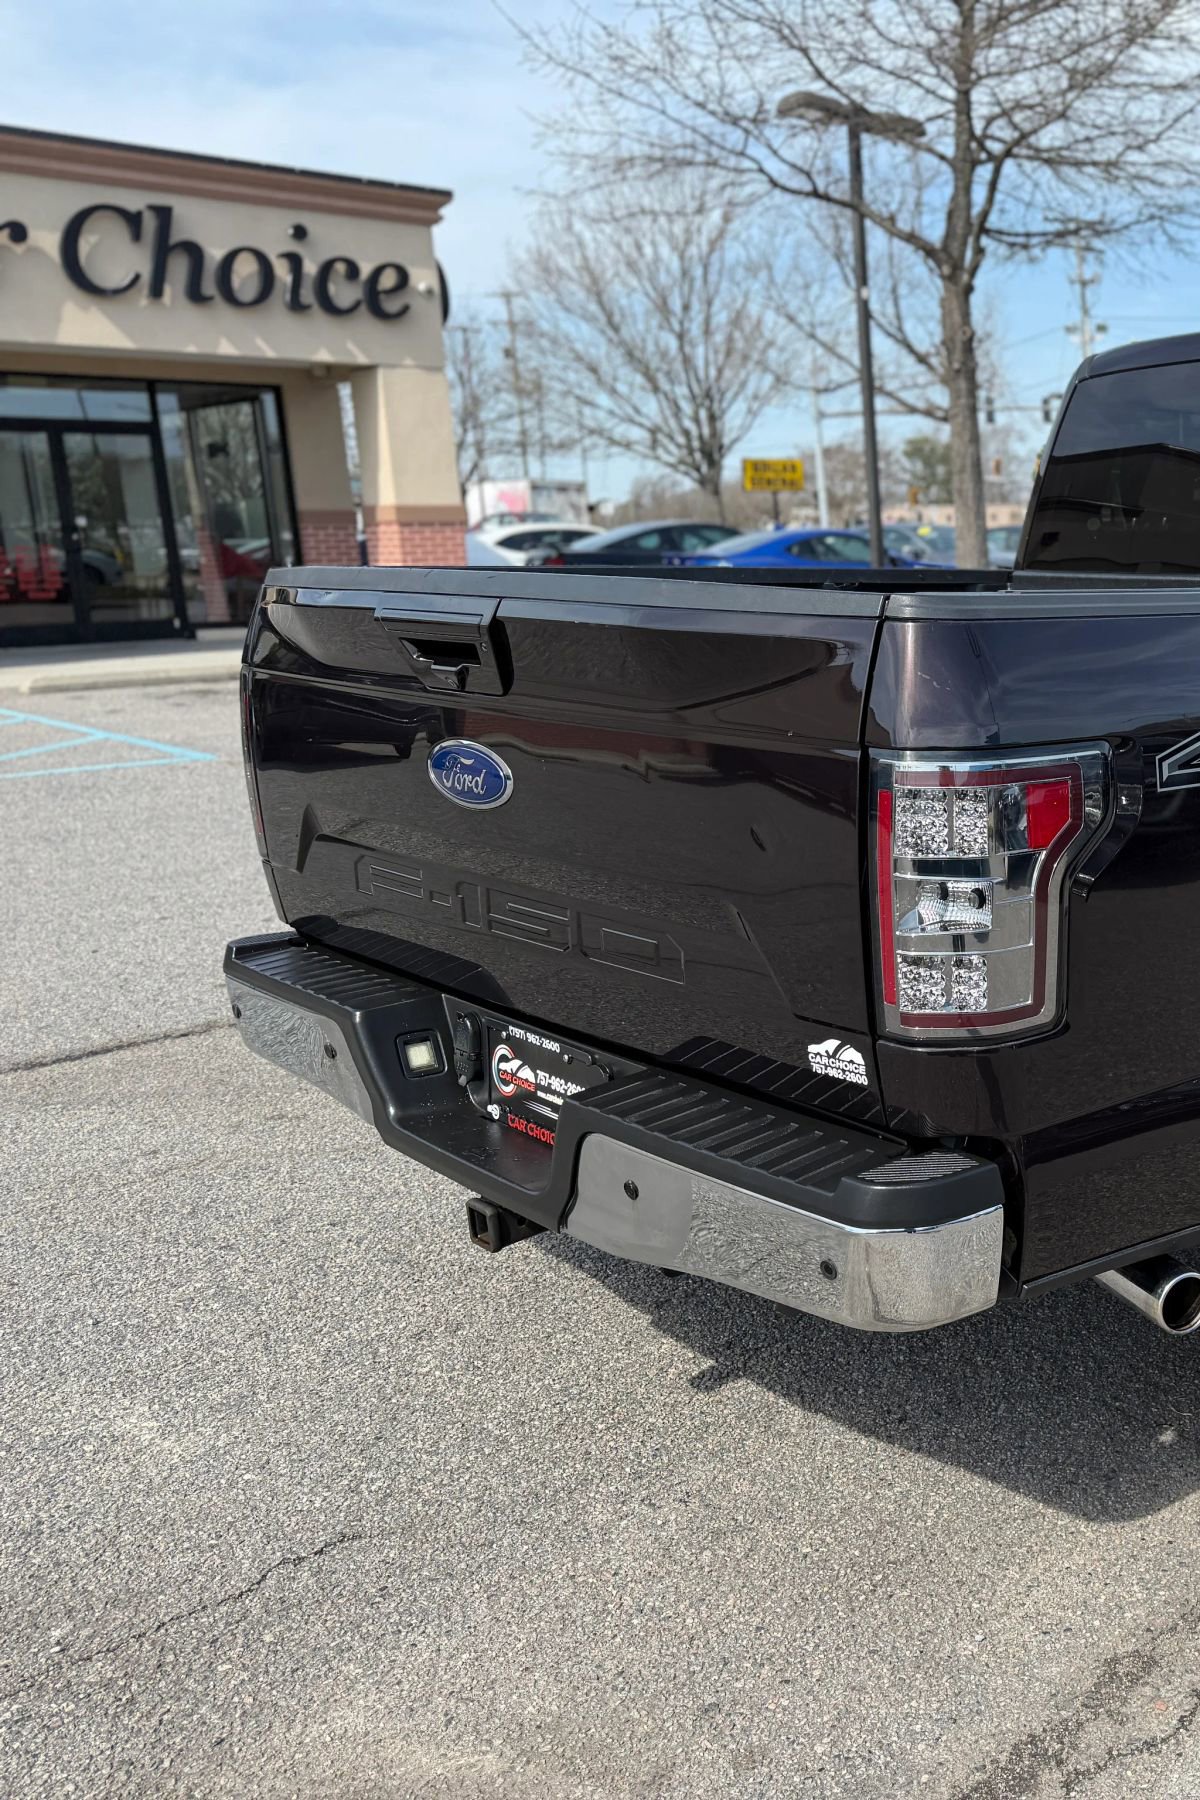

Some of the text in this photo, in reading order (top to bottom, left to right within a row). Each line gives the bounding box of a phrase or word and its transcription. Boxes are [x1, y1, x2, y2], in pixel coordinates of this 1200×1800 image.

[60, 203, 412, 321] Choice
[442, 753, 487, 795] Ford
[354, 854, 686, 985] F-150
[508, 1025, 561, 1054] (757) 962-2600
[499, 1070, 536, 1092] CAR CHOICE
[810, 1062, 869, 1086] 757-962-2600
[507, 1112, 527, 1134] CAR
